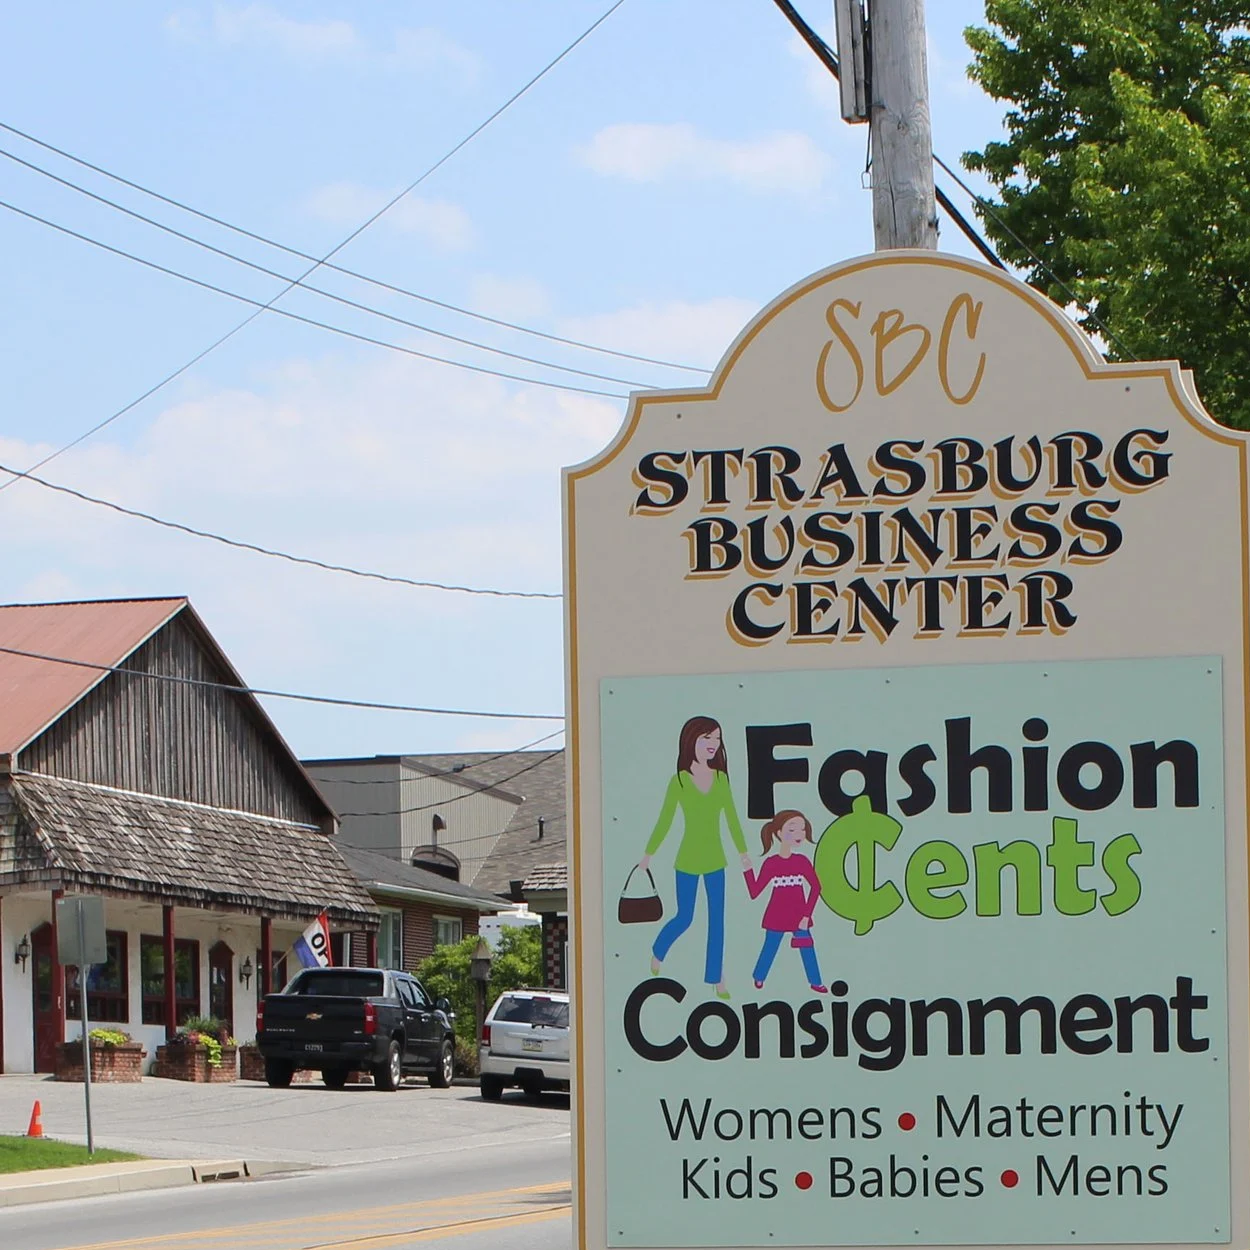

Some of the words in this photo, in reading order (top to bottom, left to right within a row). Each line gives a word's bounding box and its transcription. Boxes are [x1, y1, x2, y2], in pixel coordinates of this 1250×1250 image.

[816, 293, 986, 412] SBC
[630, 428, 1173, 516] STRASBURG
[681, 500, 1124, 580] BUSINESS
[726, 571, 1078, 648] CENTER
[746, 717, 1200, 820] Fashion
[623, 976, 1210, 1072] Consignment
[660, 1098, 882, 1141] Womens
[935, 1091, 1184, 1149] Maternity
[681, 1156, 778, 1199] Kids
[829, 1155, 984, 1198] Babies
[1035, 1154, 1169, 1196] Mens
